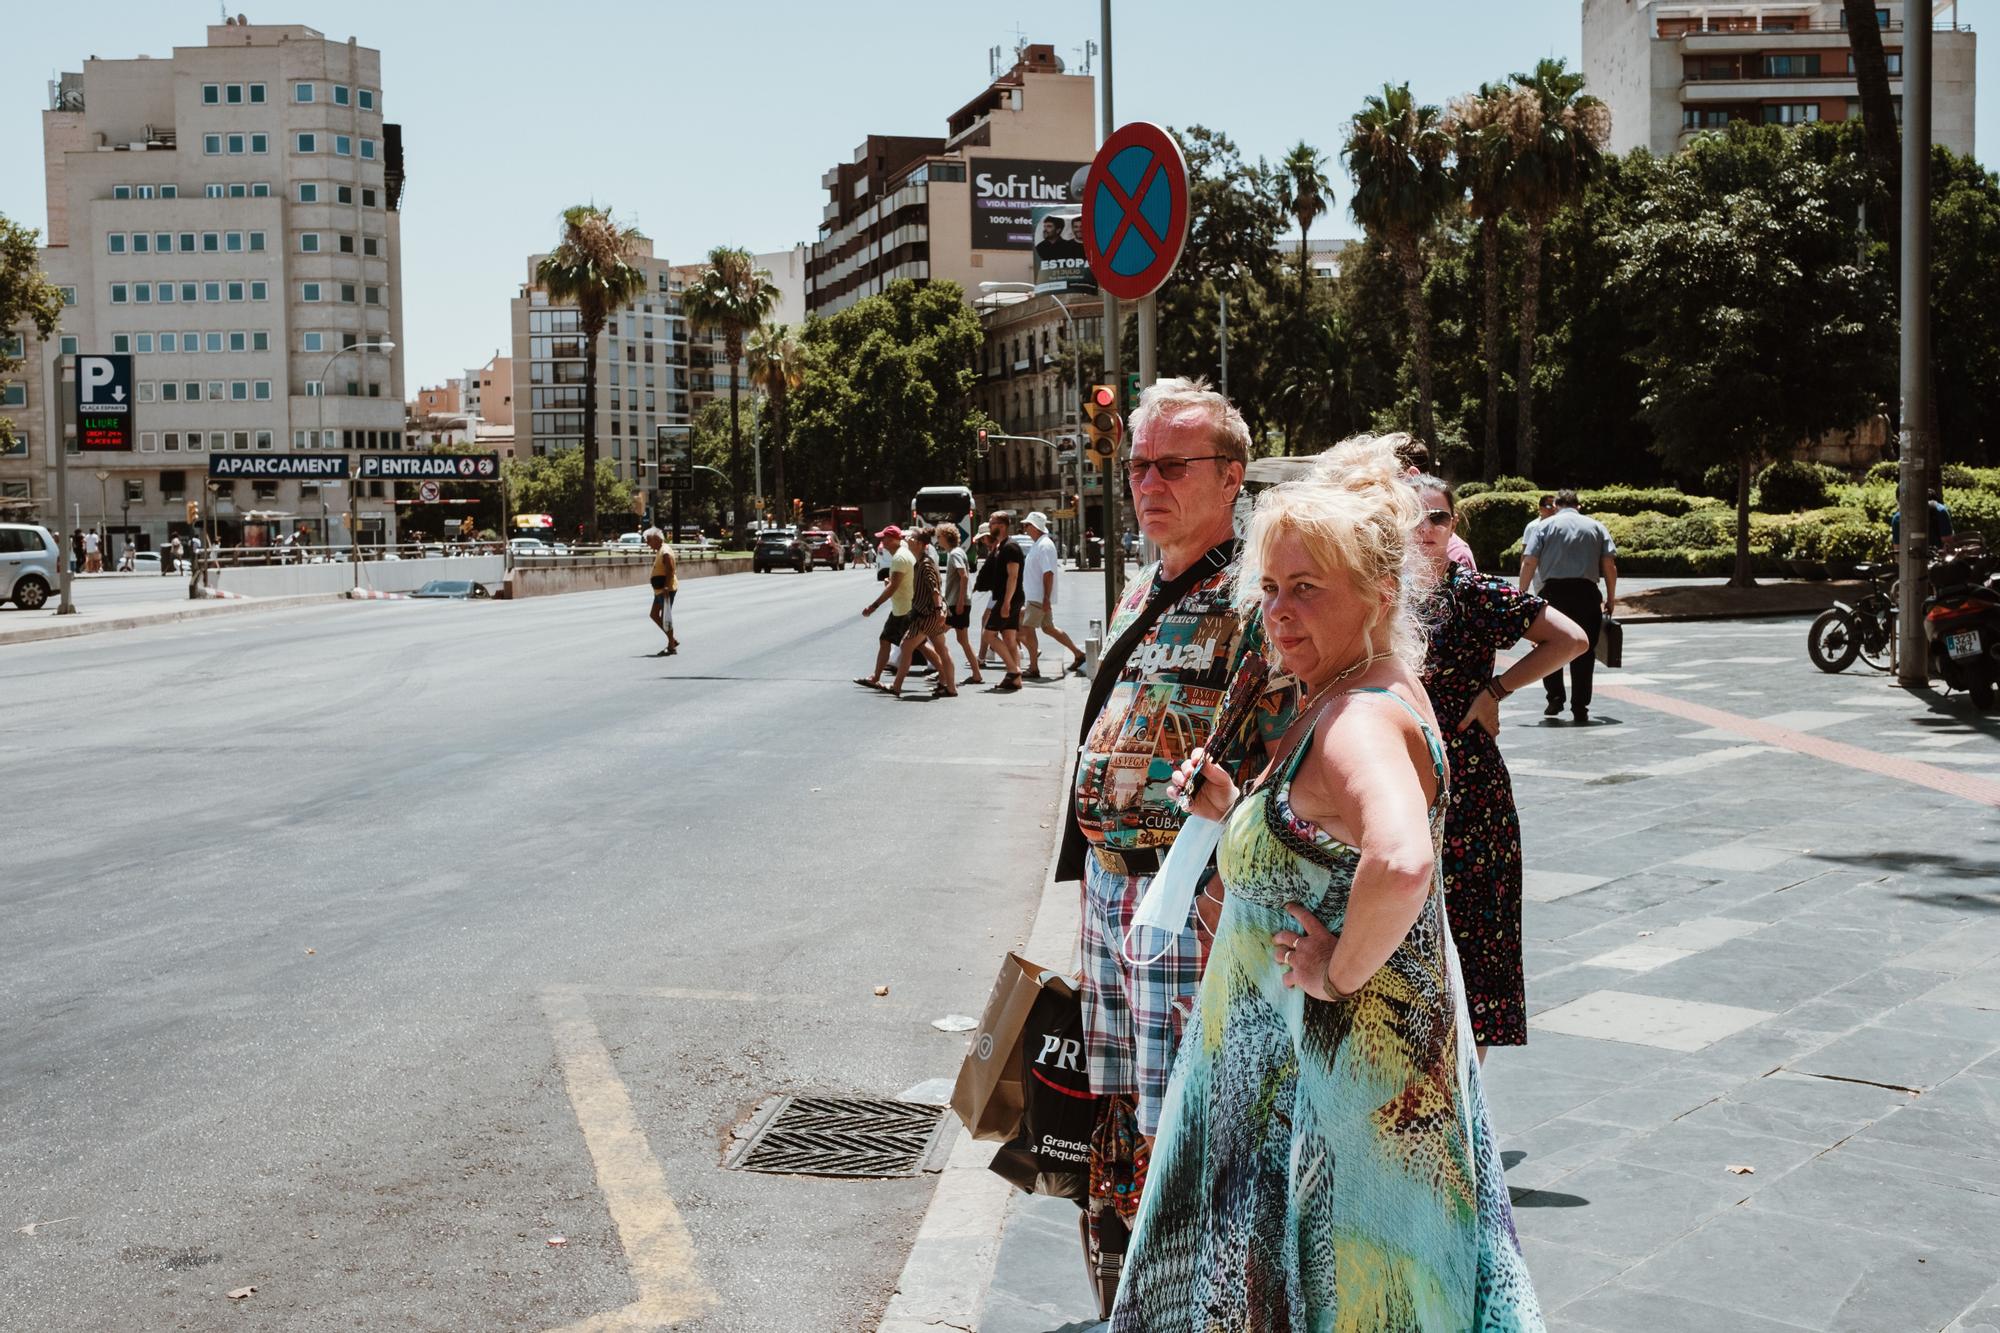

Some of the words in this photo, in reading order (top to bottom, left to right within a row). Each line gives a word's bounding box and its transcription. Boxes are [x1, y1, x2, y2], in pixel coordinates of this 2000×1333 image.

[986, 200, 1007, 208] VIDA
[989, 215, 1012, 224] 100%
[81, 357, 115, 402] P
[216, 458, 343, 473] APARCAMENT
[365, 459, 378, 474] P
[382, 459, 457, 474] ENTRADA
[1166, 615, 1198, 624] MEXICO
[1124, 757, 1151, 767] VEGAS
[1145, 815, 1181, 830] CUBA
[1035, 1034, 1089, 1073] PR
[1030, 1145, 1038, 1153] a
